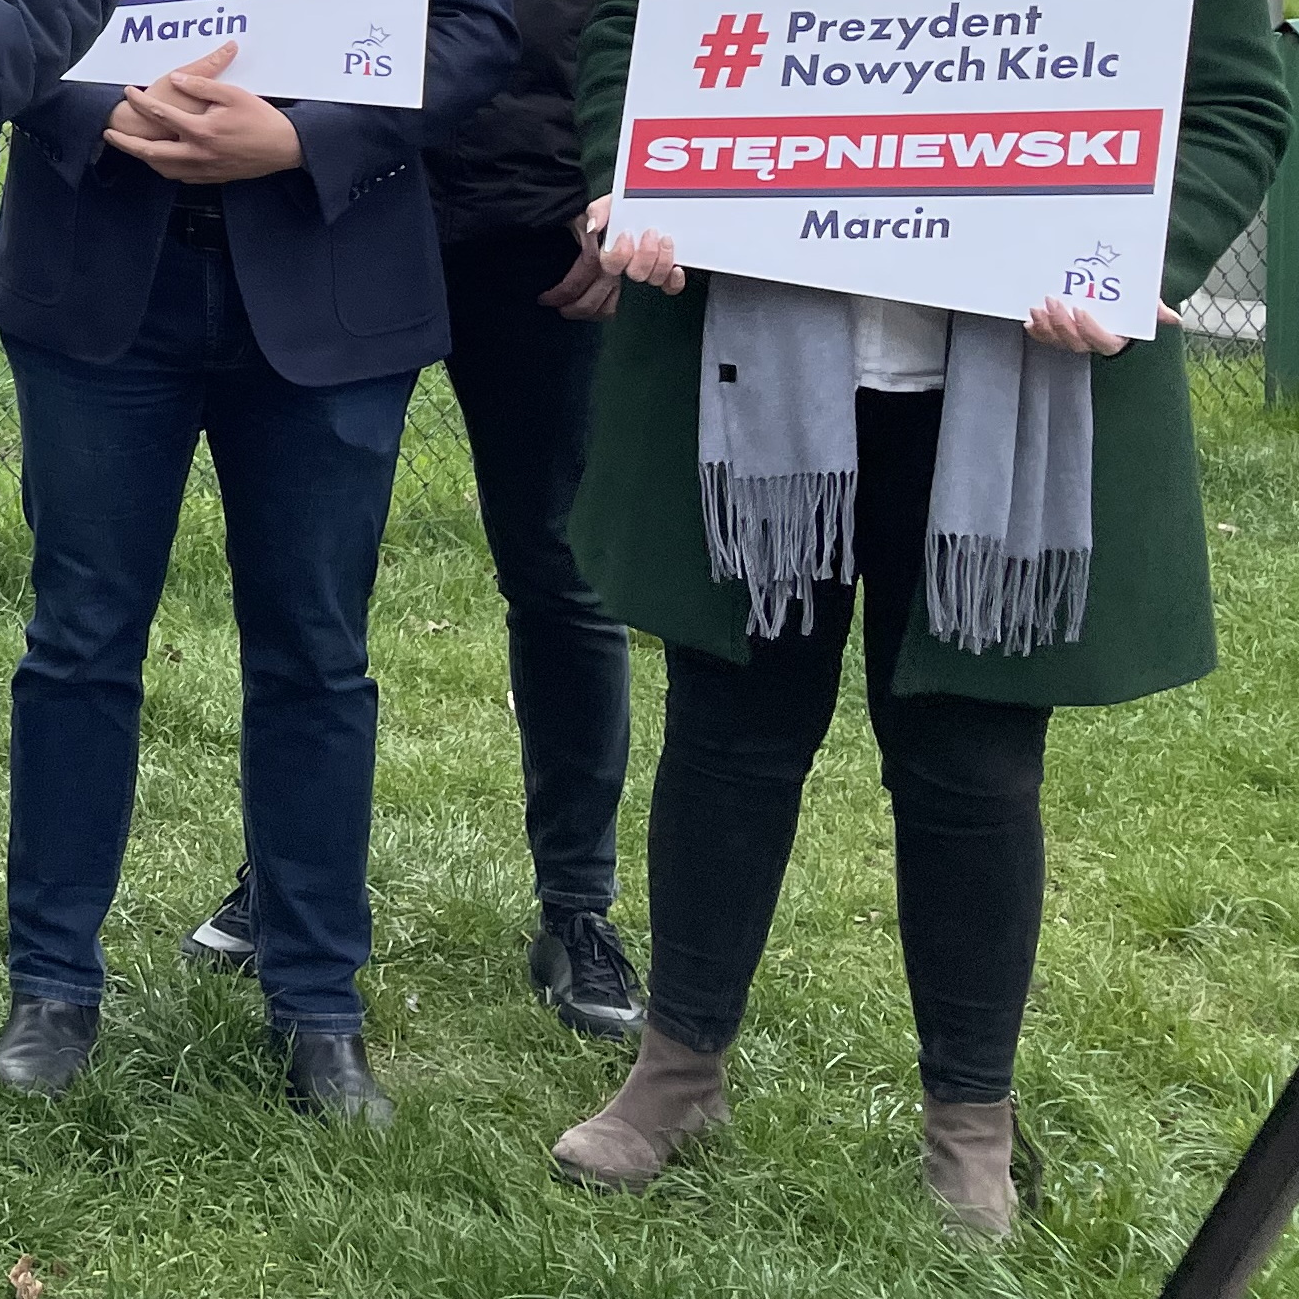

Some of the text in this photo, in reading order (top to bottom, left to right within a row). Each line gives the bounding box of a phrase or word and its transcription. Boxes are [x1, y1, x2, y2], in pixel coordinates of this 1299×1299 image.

[120, 6, 247, 44] Marcin
[786, 2, 1043, 51] Prezydent
[694, 13, 769, 88] #
[780, 41, 1120, 95] Nowych Kielc
[643, 130, 1141, 181] STĘPNIEWSKI
[799, 206, 950, 240] Marcin
